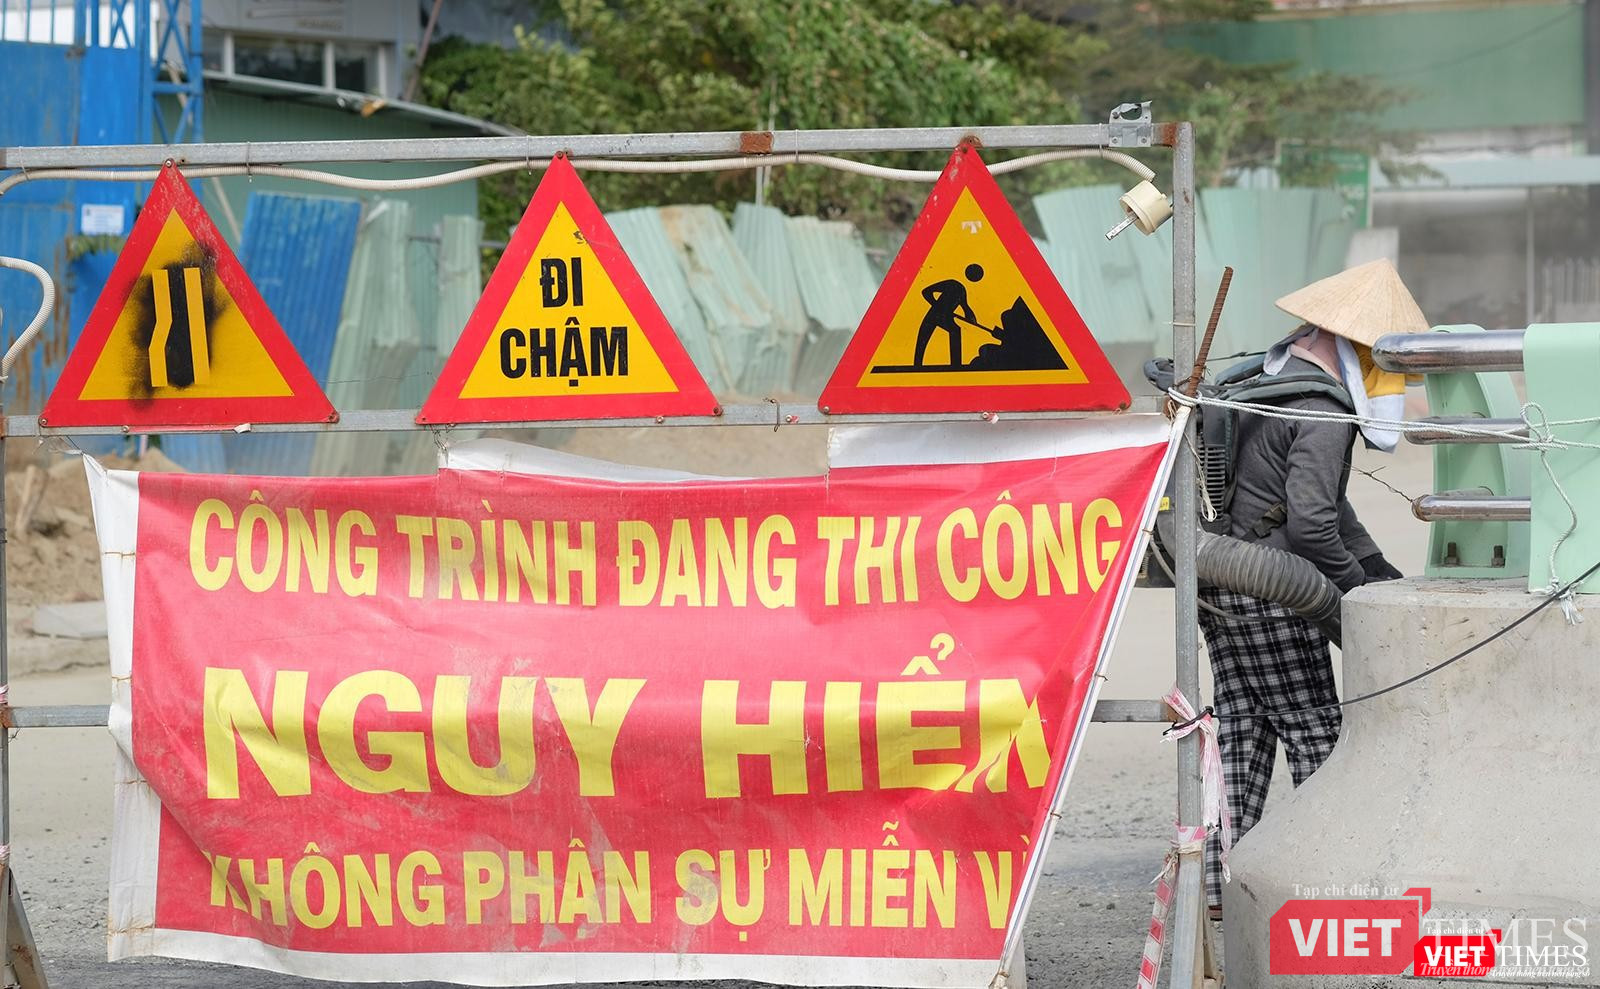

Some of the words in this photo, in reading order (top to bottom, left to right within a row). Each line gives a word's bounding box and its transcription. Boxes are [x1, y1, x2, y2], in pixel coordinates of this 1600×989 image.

[540, 257, 583, 308] ĐI
[500, 317, 629, 387] CHẬM
[189, 490, 379, 596] CÔNG
[396, 500, 597, 606] TRÌNH
[616, 514, 797, 609] ĐANG
[817, 516, 922, 606] THI
[936, 490, 1122, 602] CÔNG
[203, 667, 648, 799] NGUY
[202, 841, 445, 929] KHÔNG
[463, 838, 651, 925] PHÂN
[675, 848, 771, 942] SỰ
[788, 821, 957, 928] MIỄN
